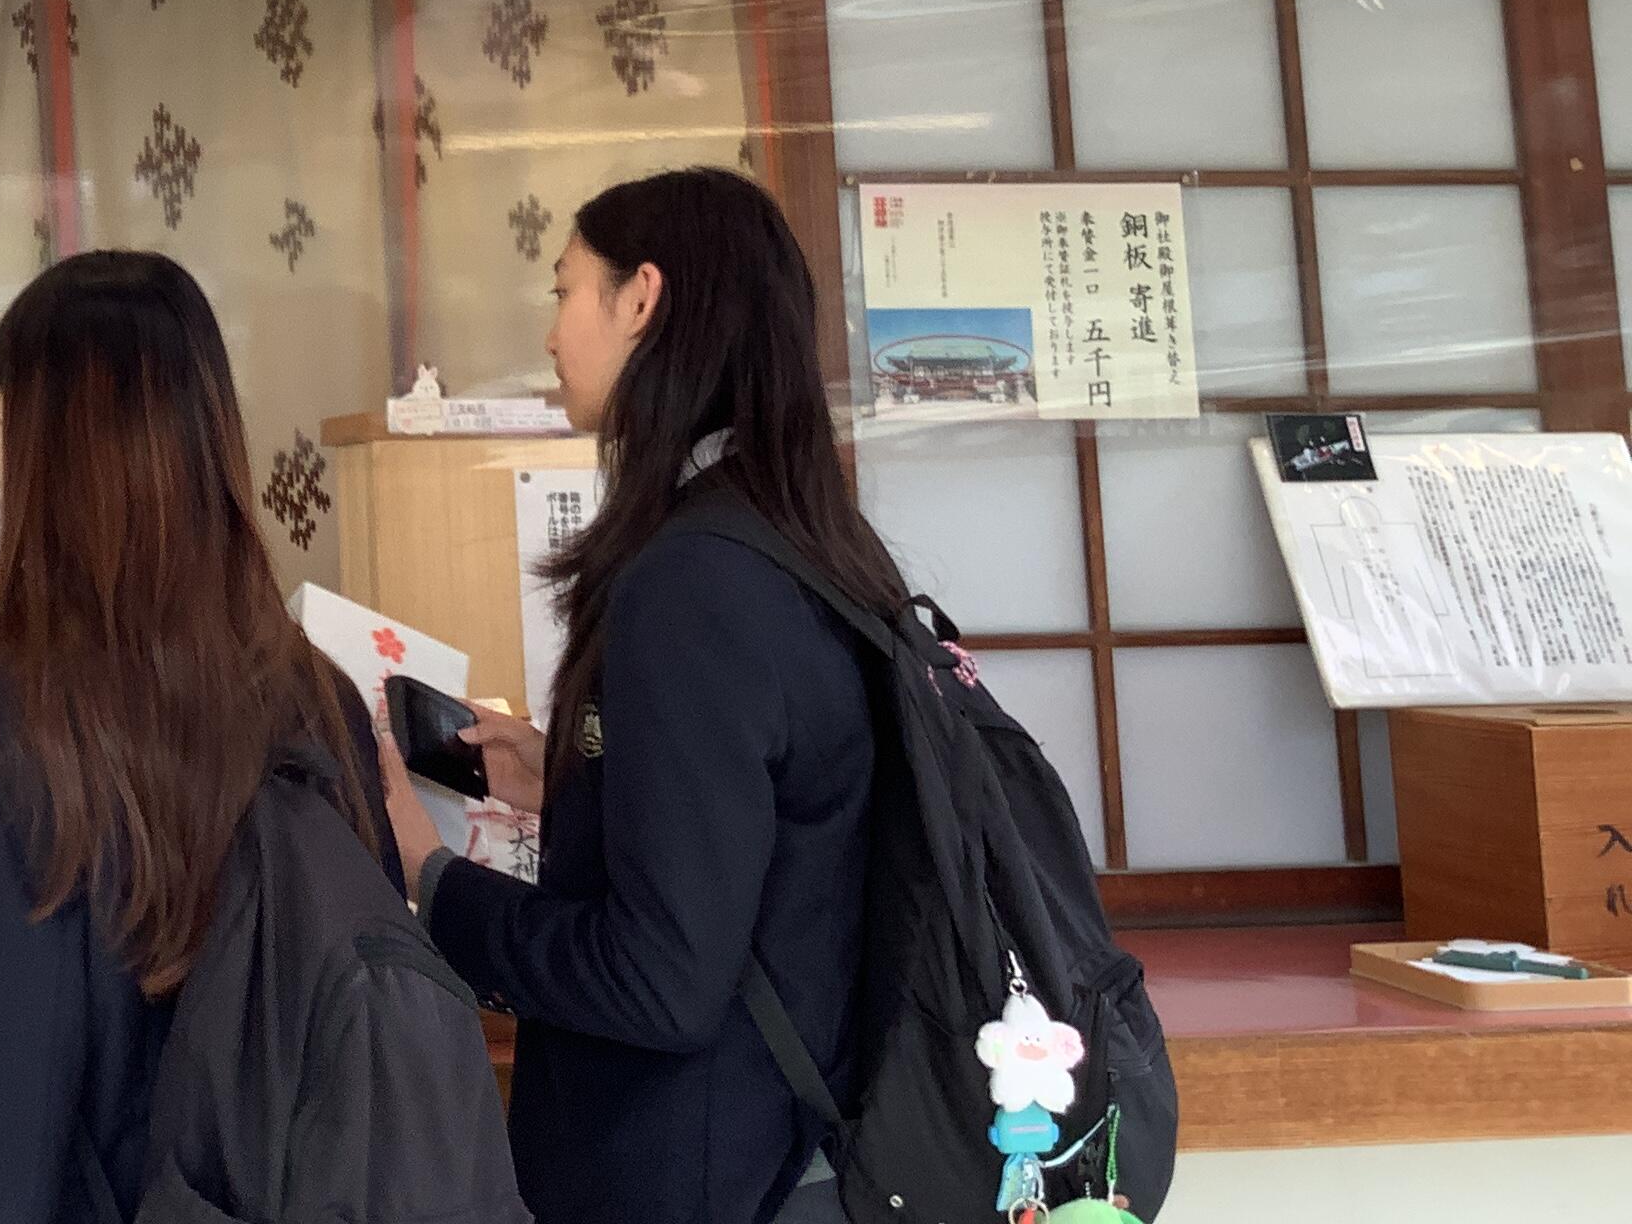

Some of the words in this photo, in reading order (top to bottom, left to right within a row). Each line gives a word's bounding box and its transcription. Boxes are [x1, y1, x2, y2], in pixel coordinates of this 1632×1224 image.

[1121, 211, 1152, 270] 銅板
[1129, 283, 1157, 343] 寄進
[1082, 319, 1112, 407] 五千円
